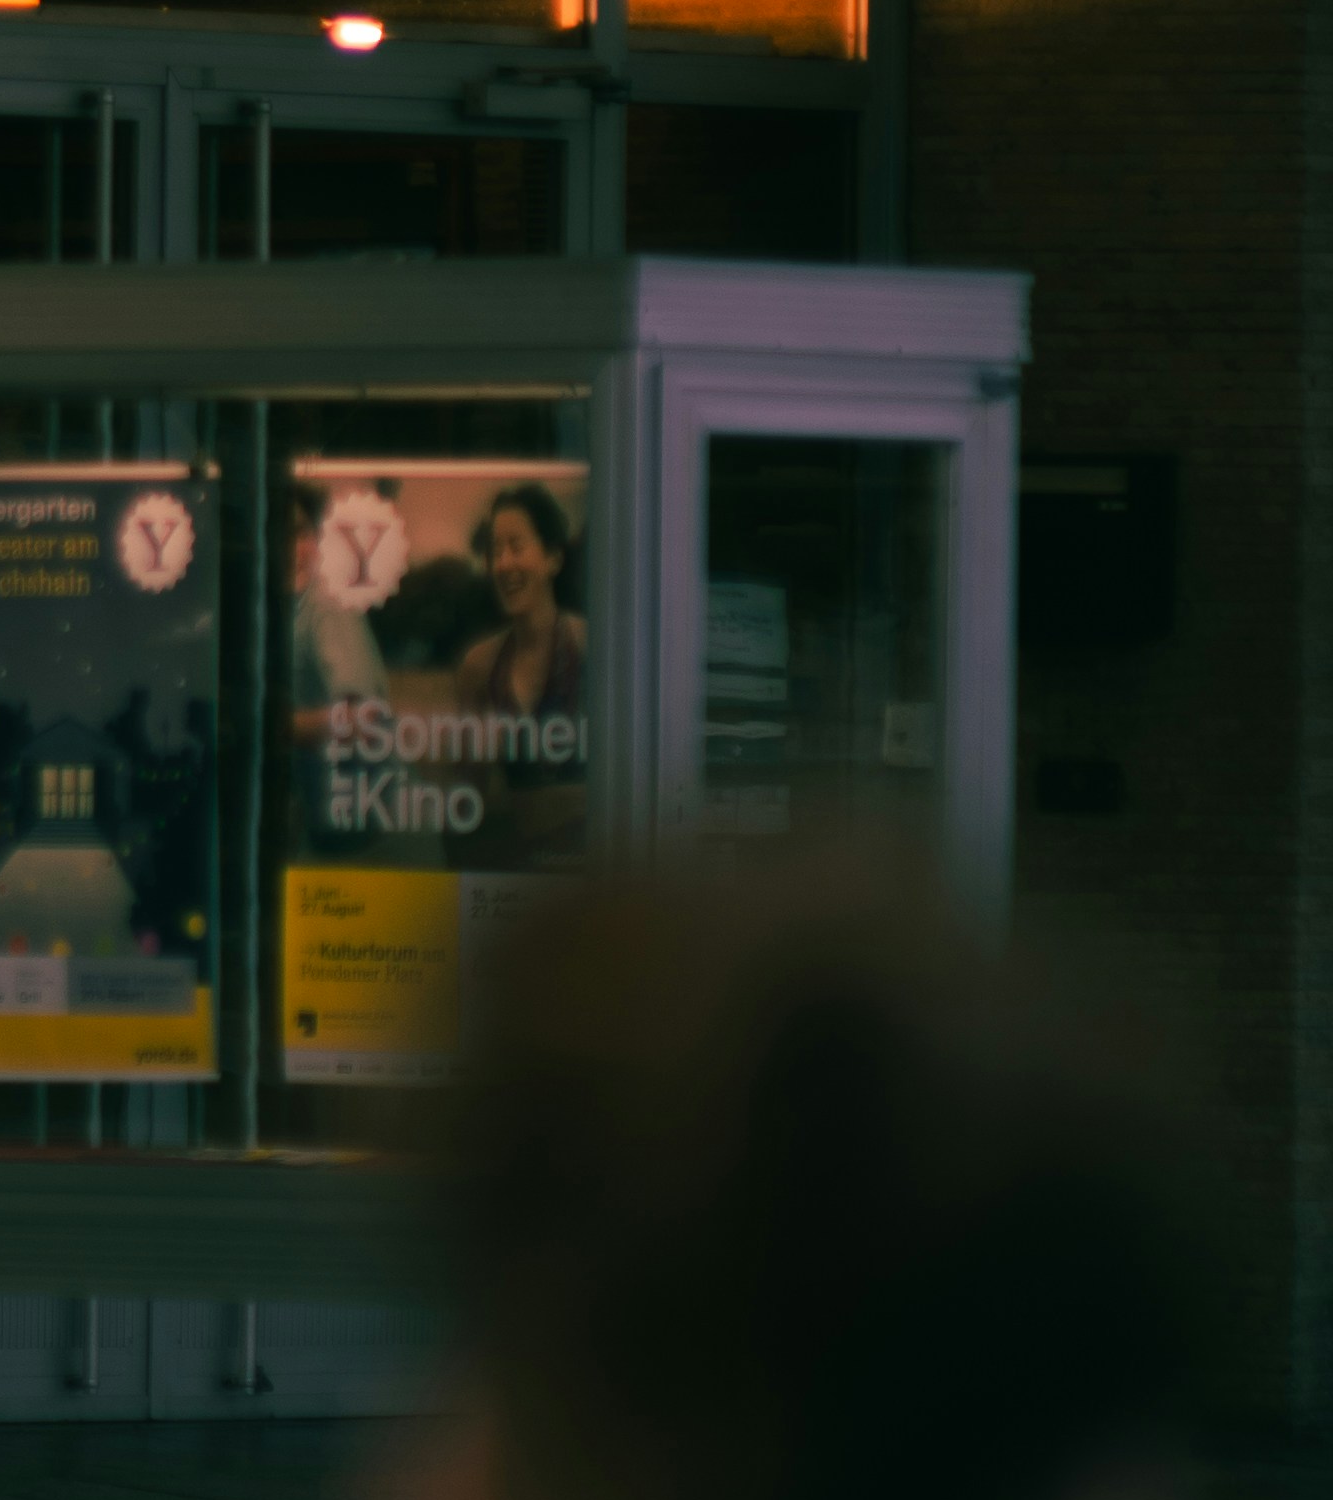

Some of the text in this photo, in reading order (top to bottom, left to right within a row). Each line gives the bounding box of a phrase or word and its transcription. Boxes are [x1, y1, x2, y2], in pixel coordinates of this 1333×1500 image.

[63, 537, 100, 559] am
[356, 768, 485, 834] Kino
[319, 940, 418, 963] Kulturforum
